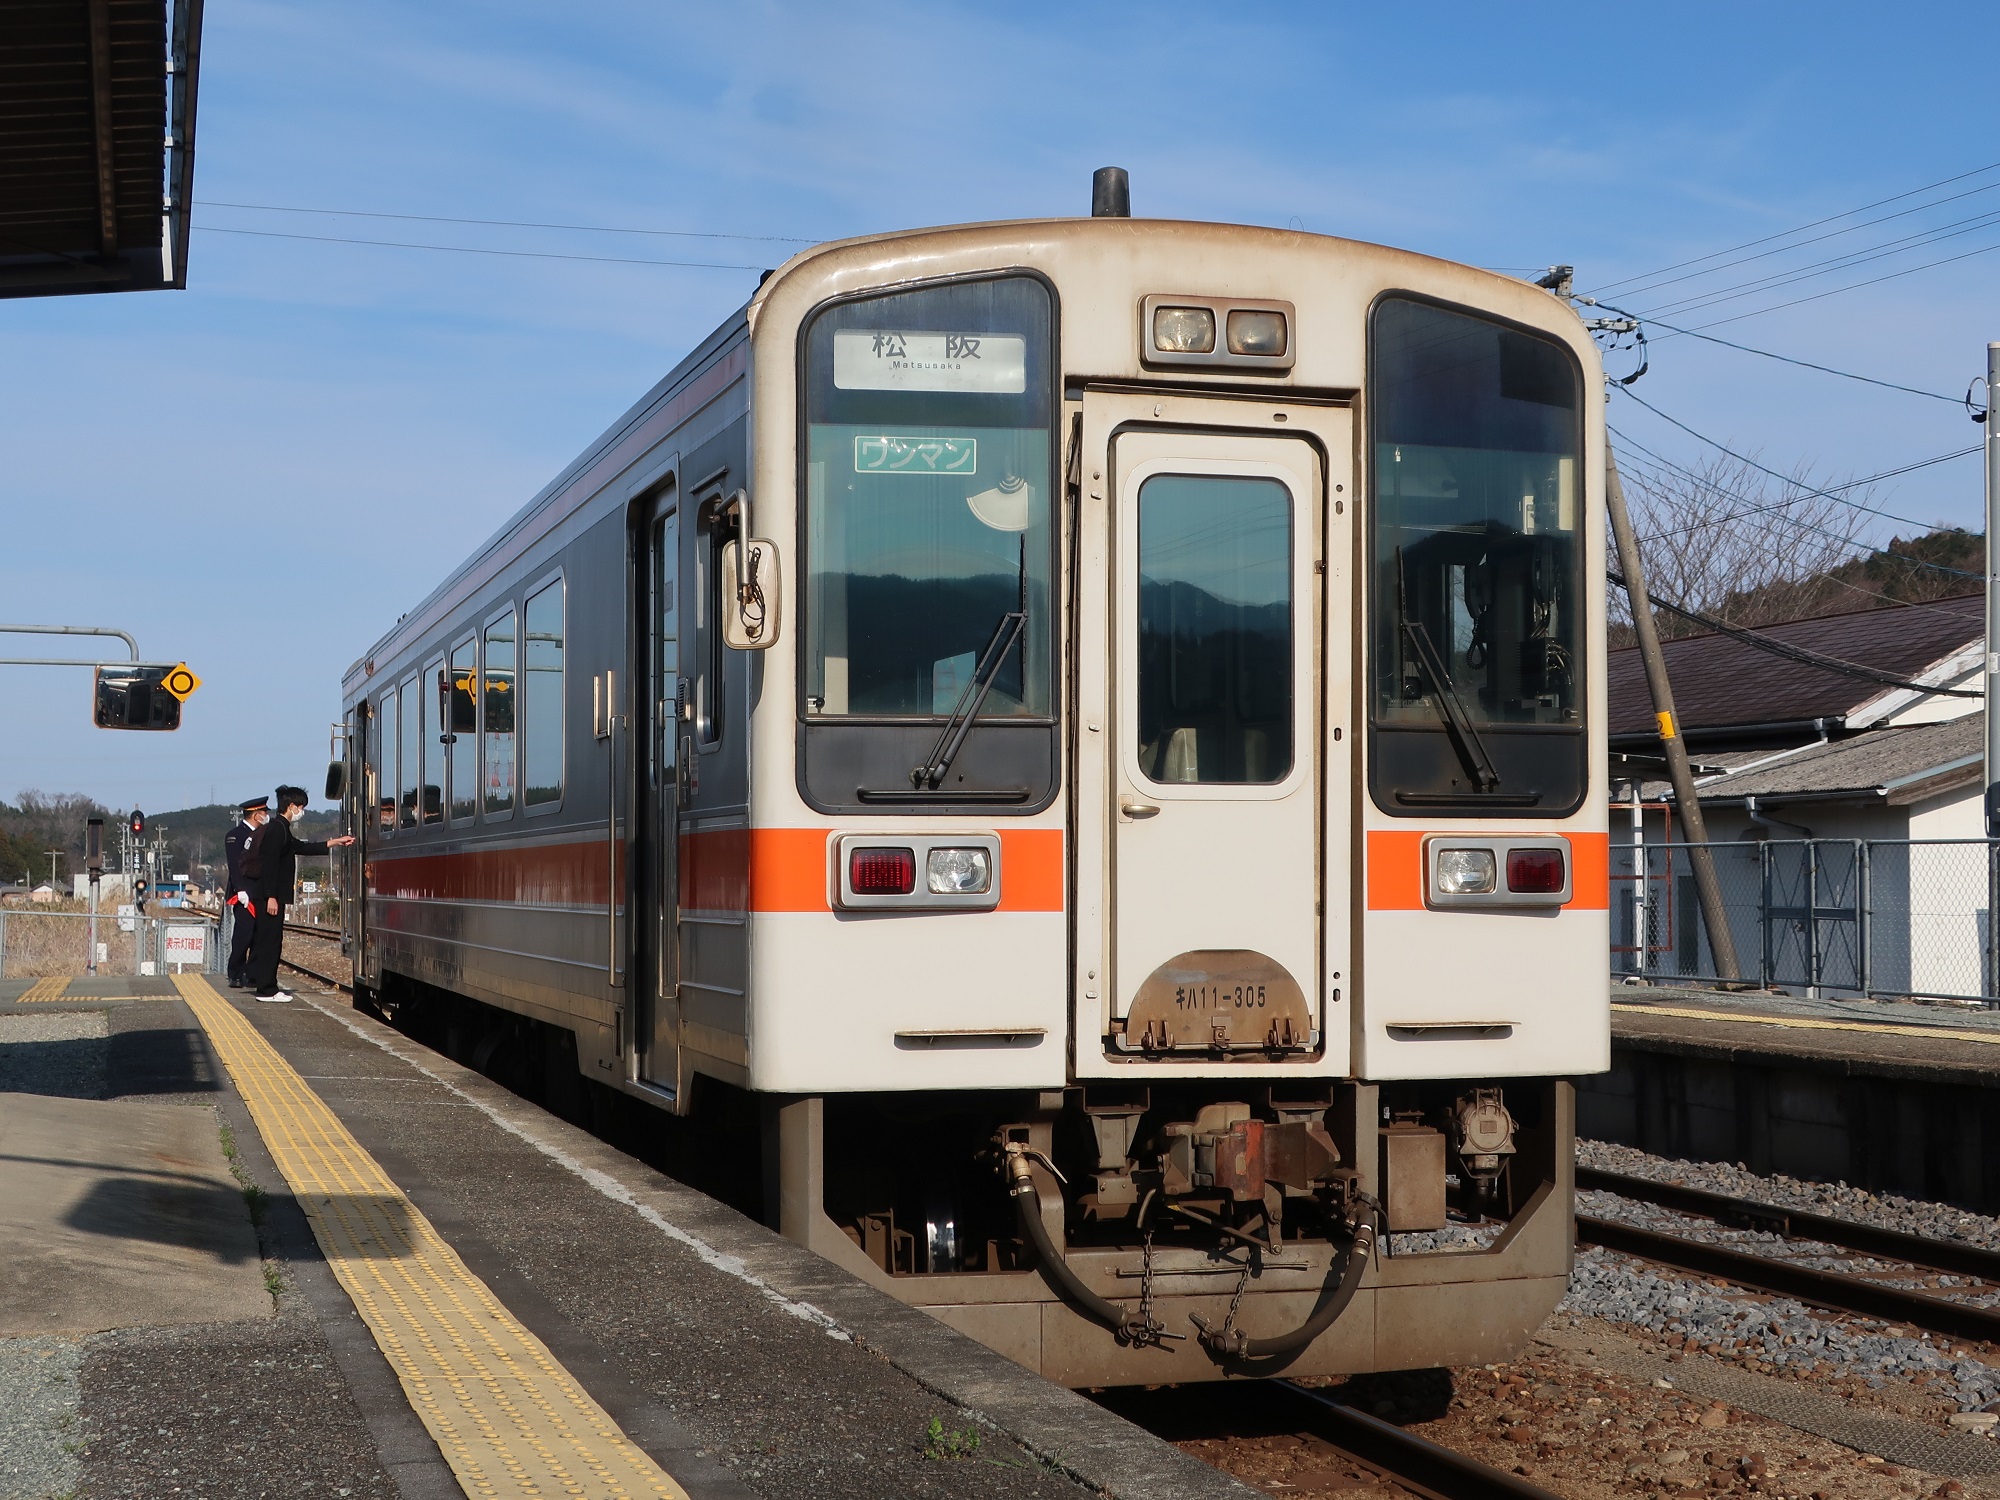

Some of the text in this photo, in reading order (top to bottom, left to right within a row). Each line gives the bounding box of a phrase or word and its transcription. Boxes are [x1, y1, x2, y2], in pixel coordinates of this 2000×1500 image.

[872, 331, 982, 360] 松阪
[892, 360, 961, 370] Matsusaka
[862, 439, 971, 469] ワンマン
[166, 937, 203, 950] 表示灯確認
[1176, 985, 1266, 1010] キハ11-305
